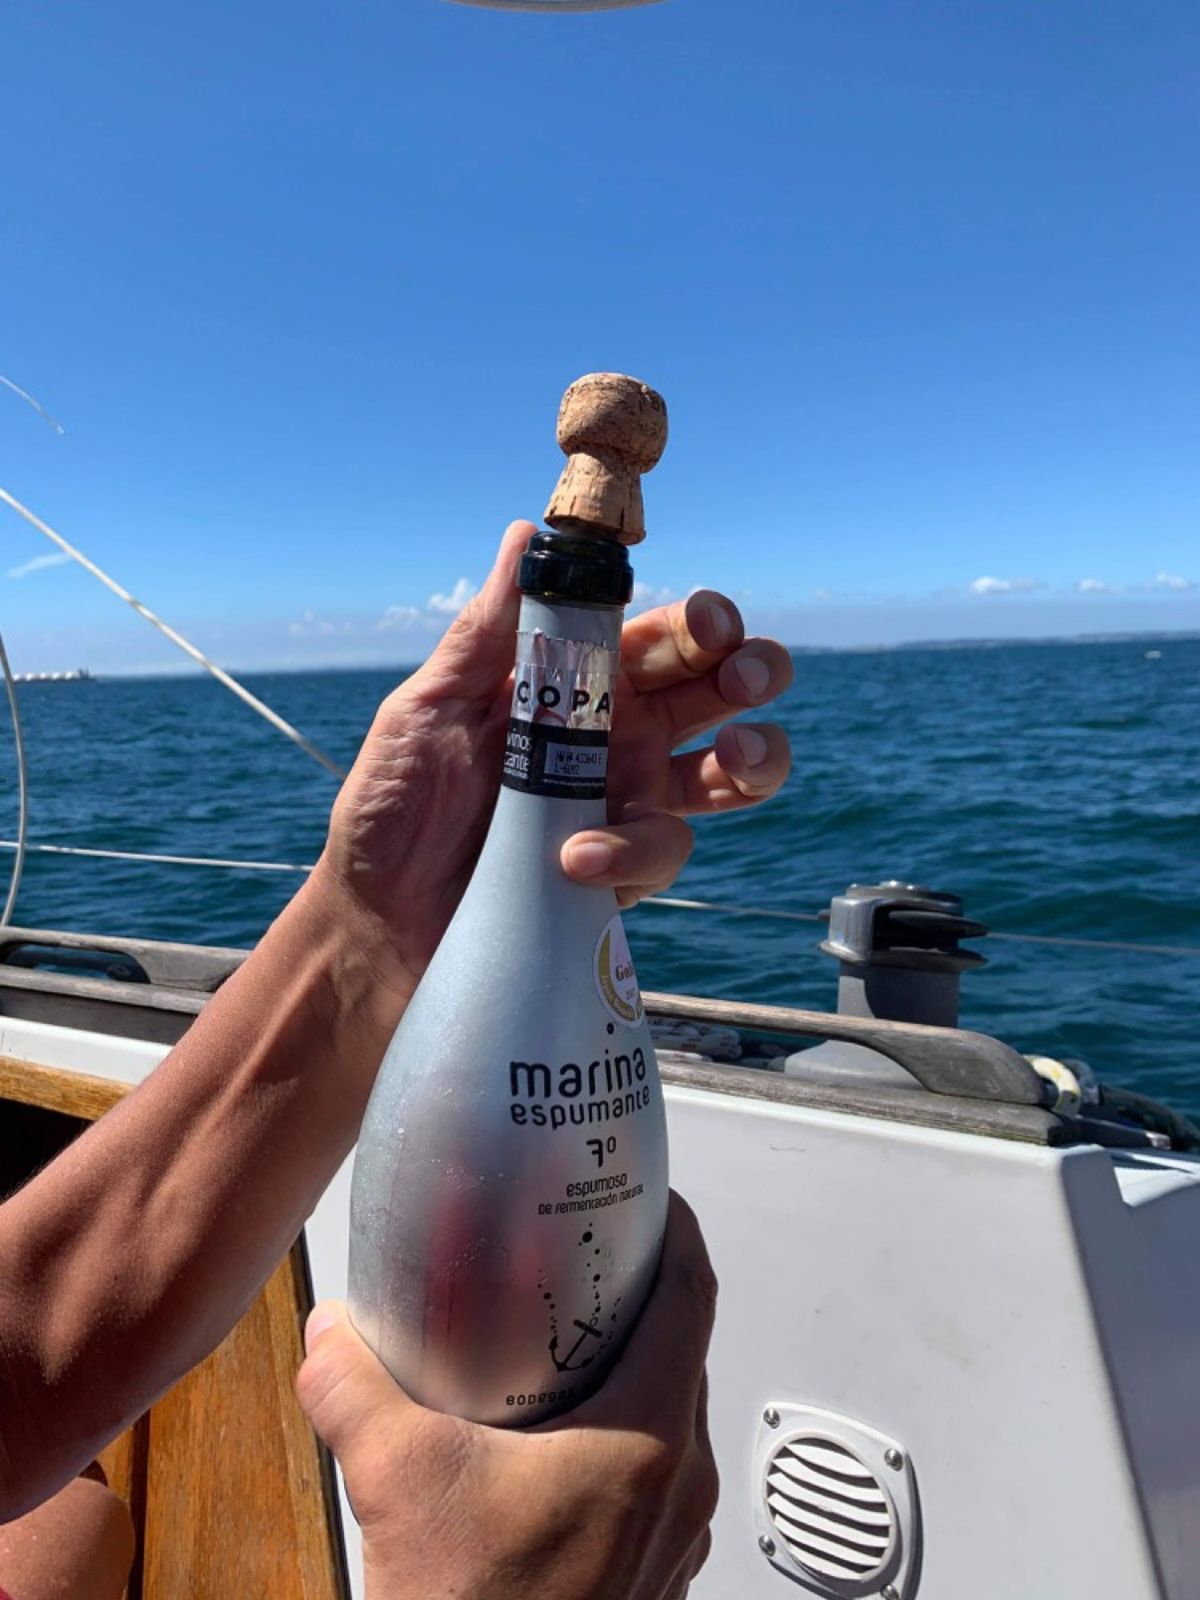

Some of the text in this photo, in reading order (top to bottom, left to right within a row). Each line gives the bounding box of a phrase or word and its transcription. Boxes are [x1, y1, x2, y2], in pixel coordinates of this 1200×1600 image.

[517, 681, 610, 714] COPA
[509, 1047, 646, 1098] marina
[510, 1085, 650, 1130] espumante
[566, 1173, 627, 1198] espumoso
